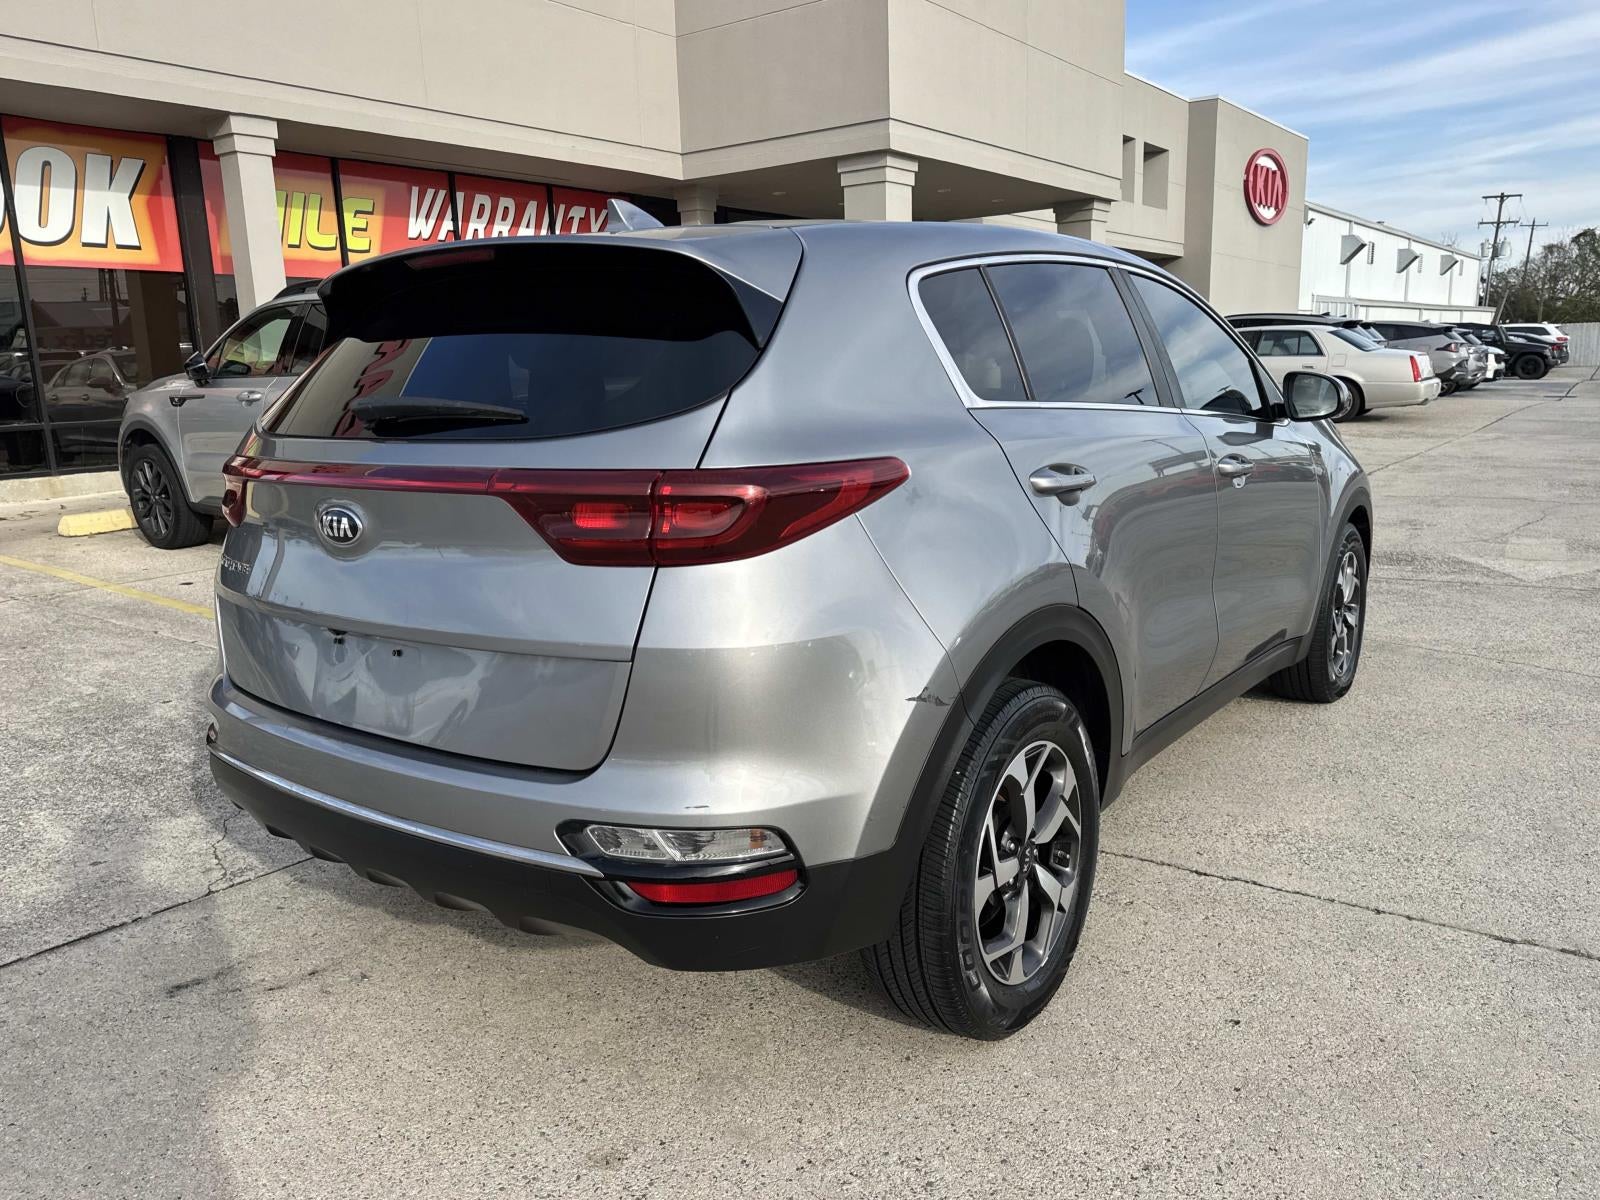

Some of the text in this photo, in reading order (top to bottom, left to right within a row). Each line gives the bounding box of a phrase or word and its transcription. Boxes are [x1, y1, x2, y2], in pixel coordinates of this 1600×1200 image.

[0, 146, 146, 250] OK
[276, 186, 608, 253] ILE WARRANTY
[322, 515, 354, 538] KIA
